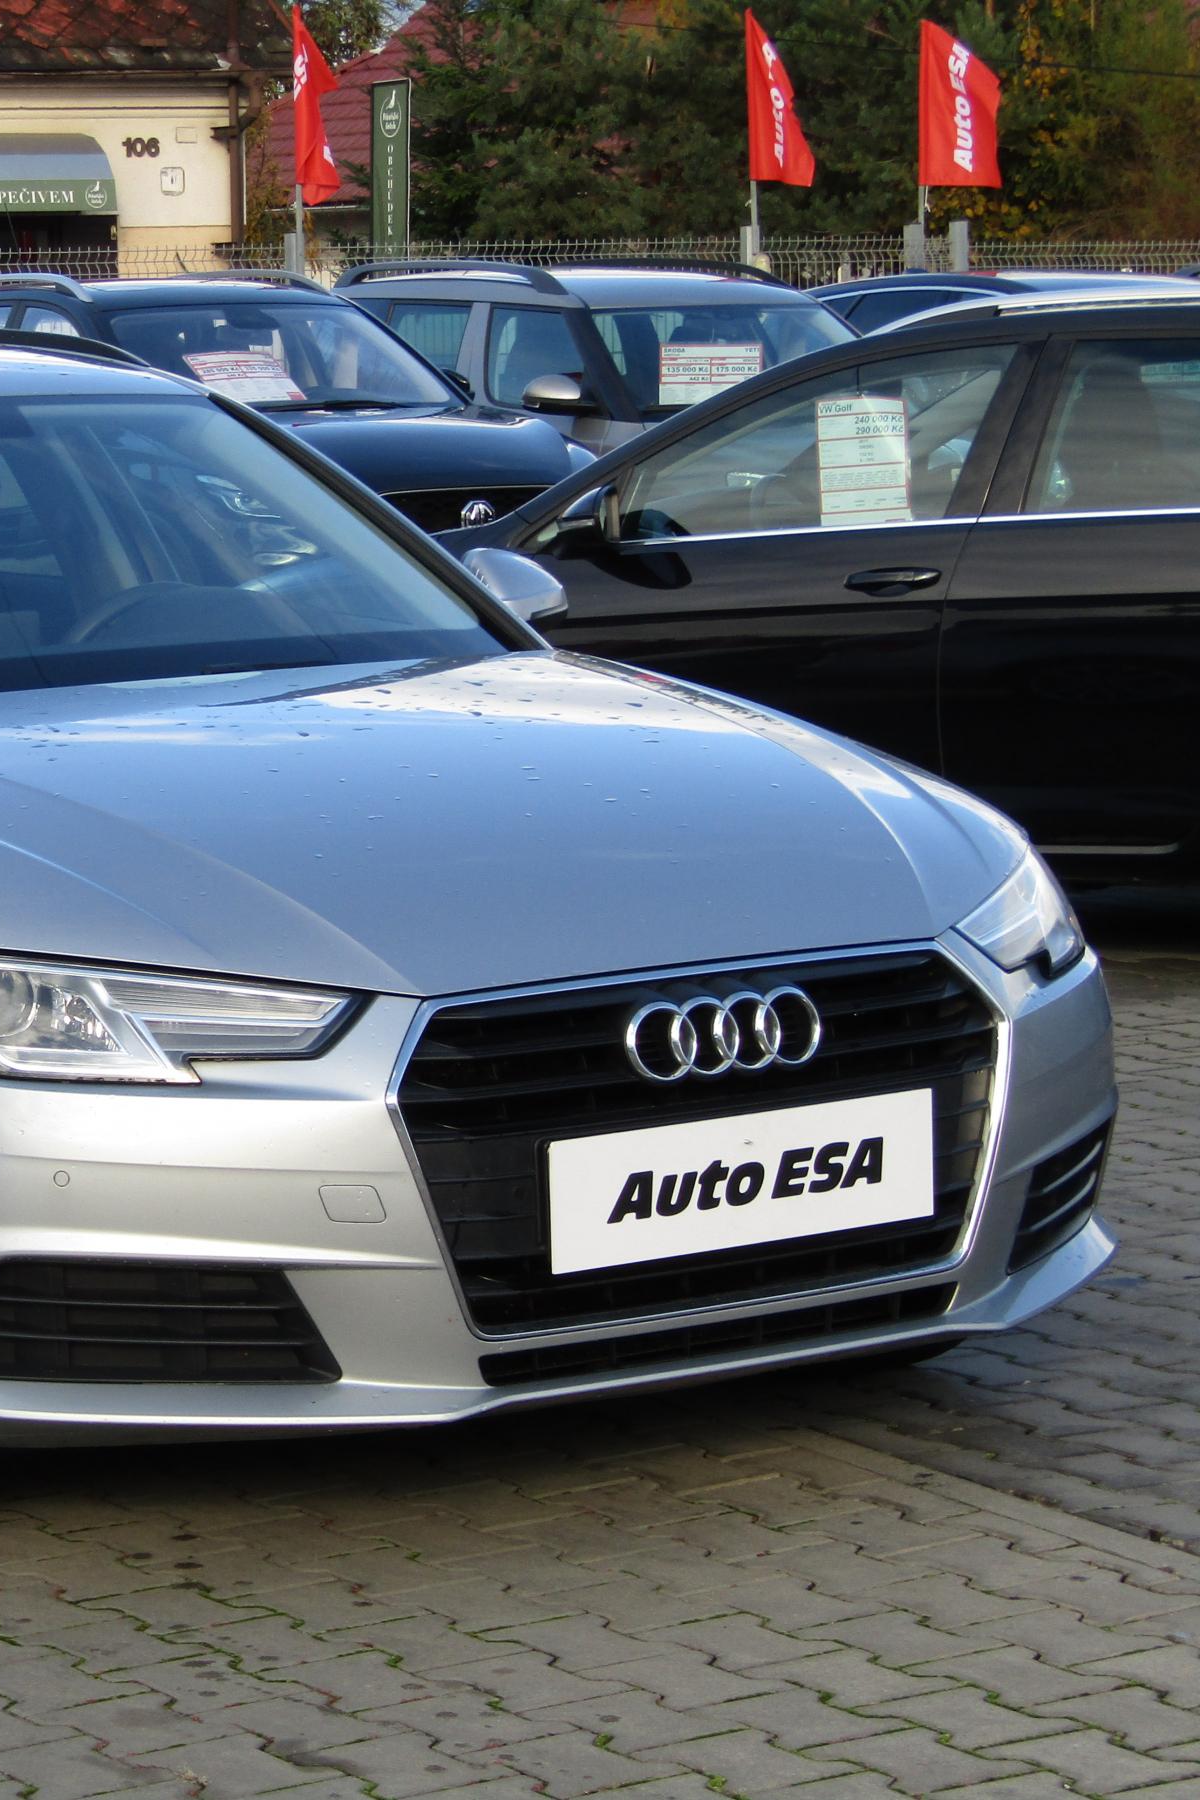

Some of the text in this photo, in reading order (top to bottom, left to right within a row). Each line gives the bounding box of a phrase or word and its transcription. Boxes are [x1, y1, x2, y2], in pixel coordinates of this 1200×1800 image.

[948, 42, 973, 173] Auto ESA
[121, 137, 160, 158] 106
[819, 403, 852, 414] VW Golf
[854, 415, 870, 425] 240
[872, 414, 889, 423] 000
[855, 426, 871, 435] 290
[872, 425, 889, 434] 000
[606, 1136, 884, 1224] Auto ESA
